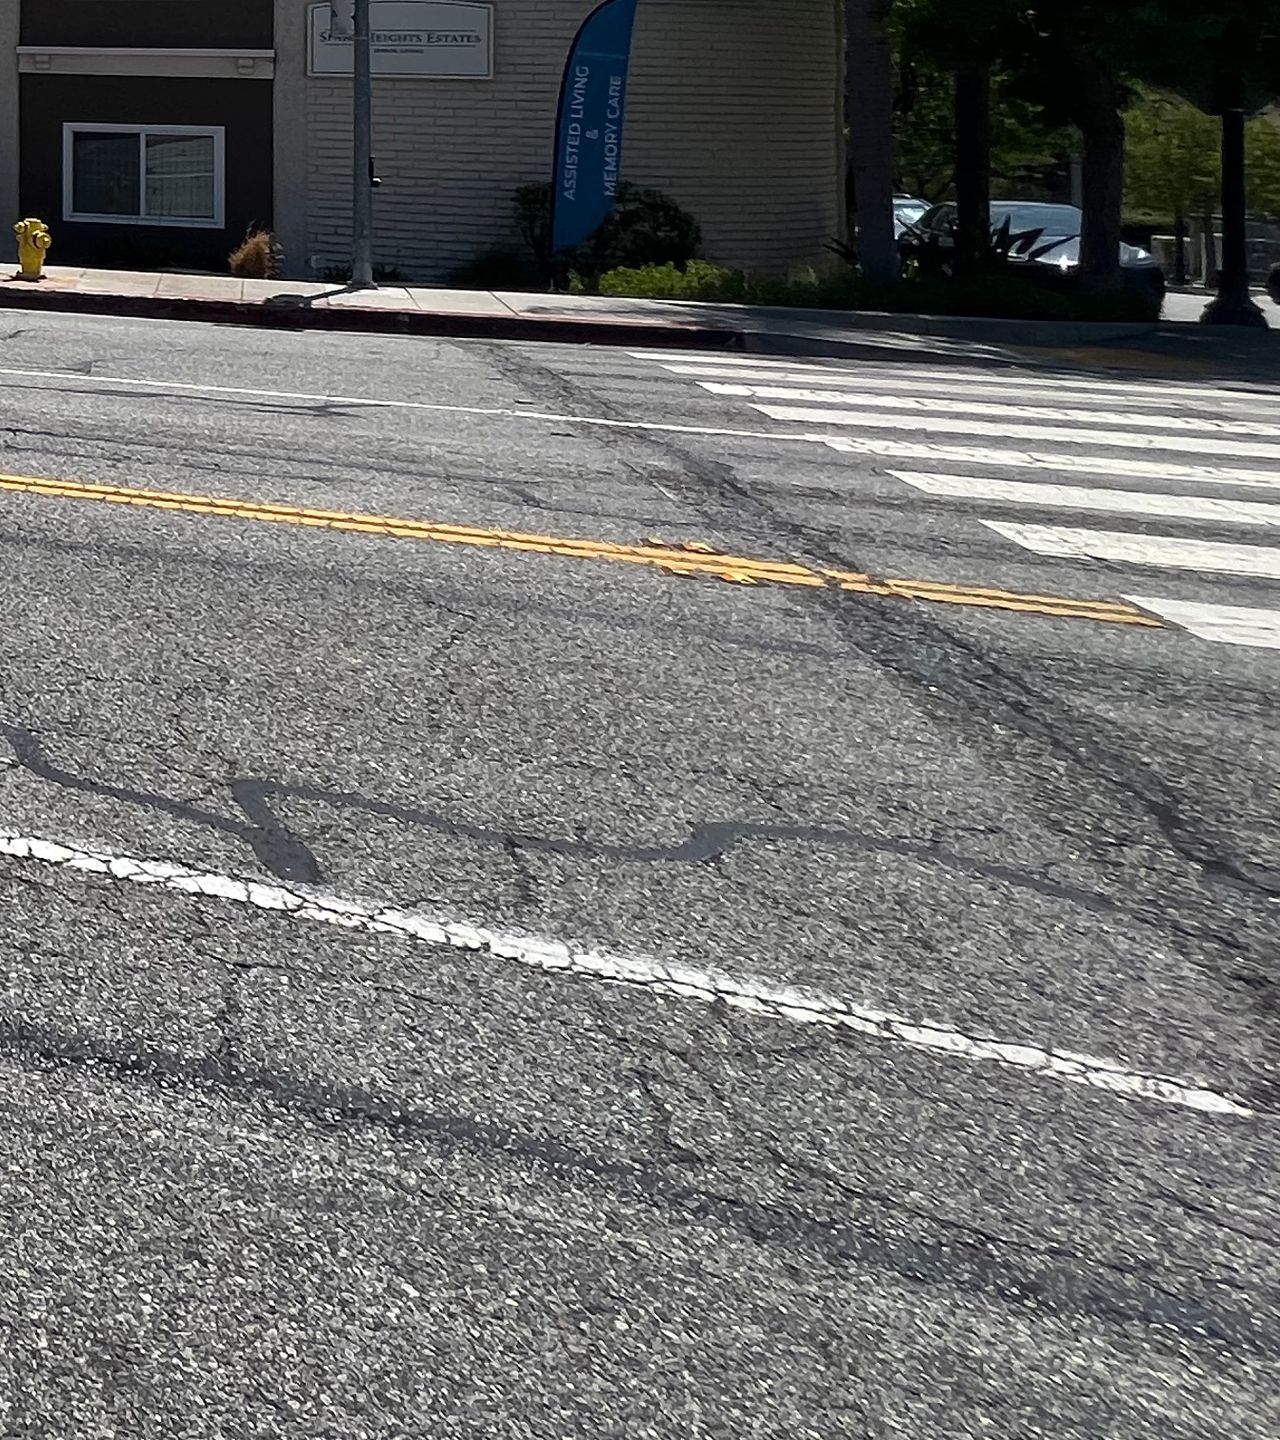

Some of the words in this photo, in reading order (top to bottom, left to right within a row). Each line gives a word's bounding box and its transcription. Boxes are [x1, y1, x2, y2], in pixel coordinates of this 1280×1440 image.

[570, 65, 590, 119] LIVING
[606, 75, 623, 120] CARE
[585, 128, 599, 140] &
[602, 122, 619, 197] MEMORY
[563, 123, 582, 201] ASSISTED
